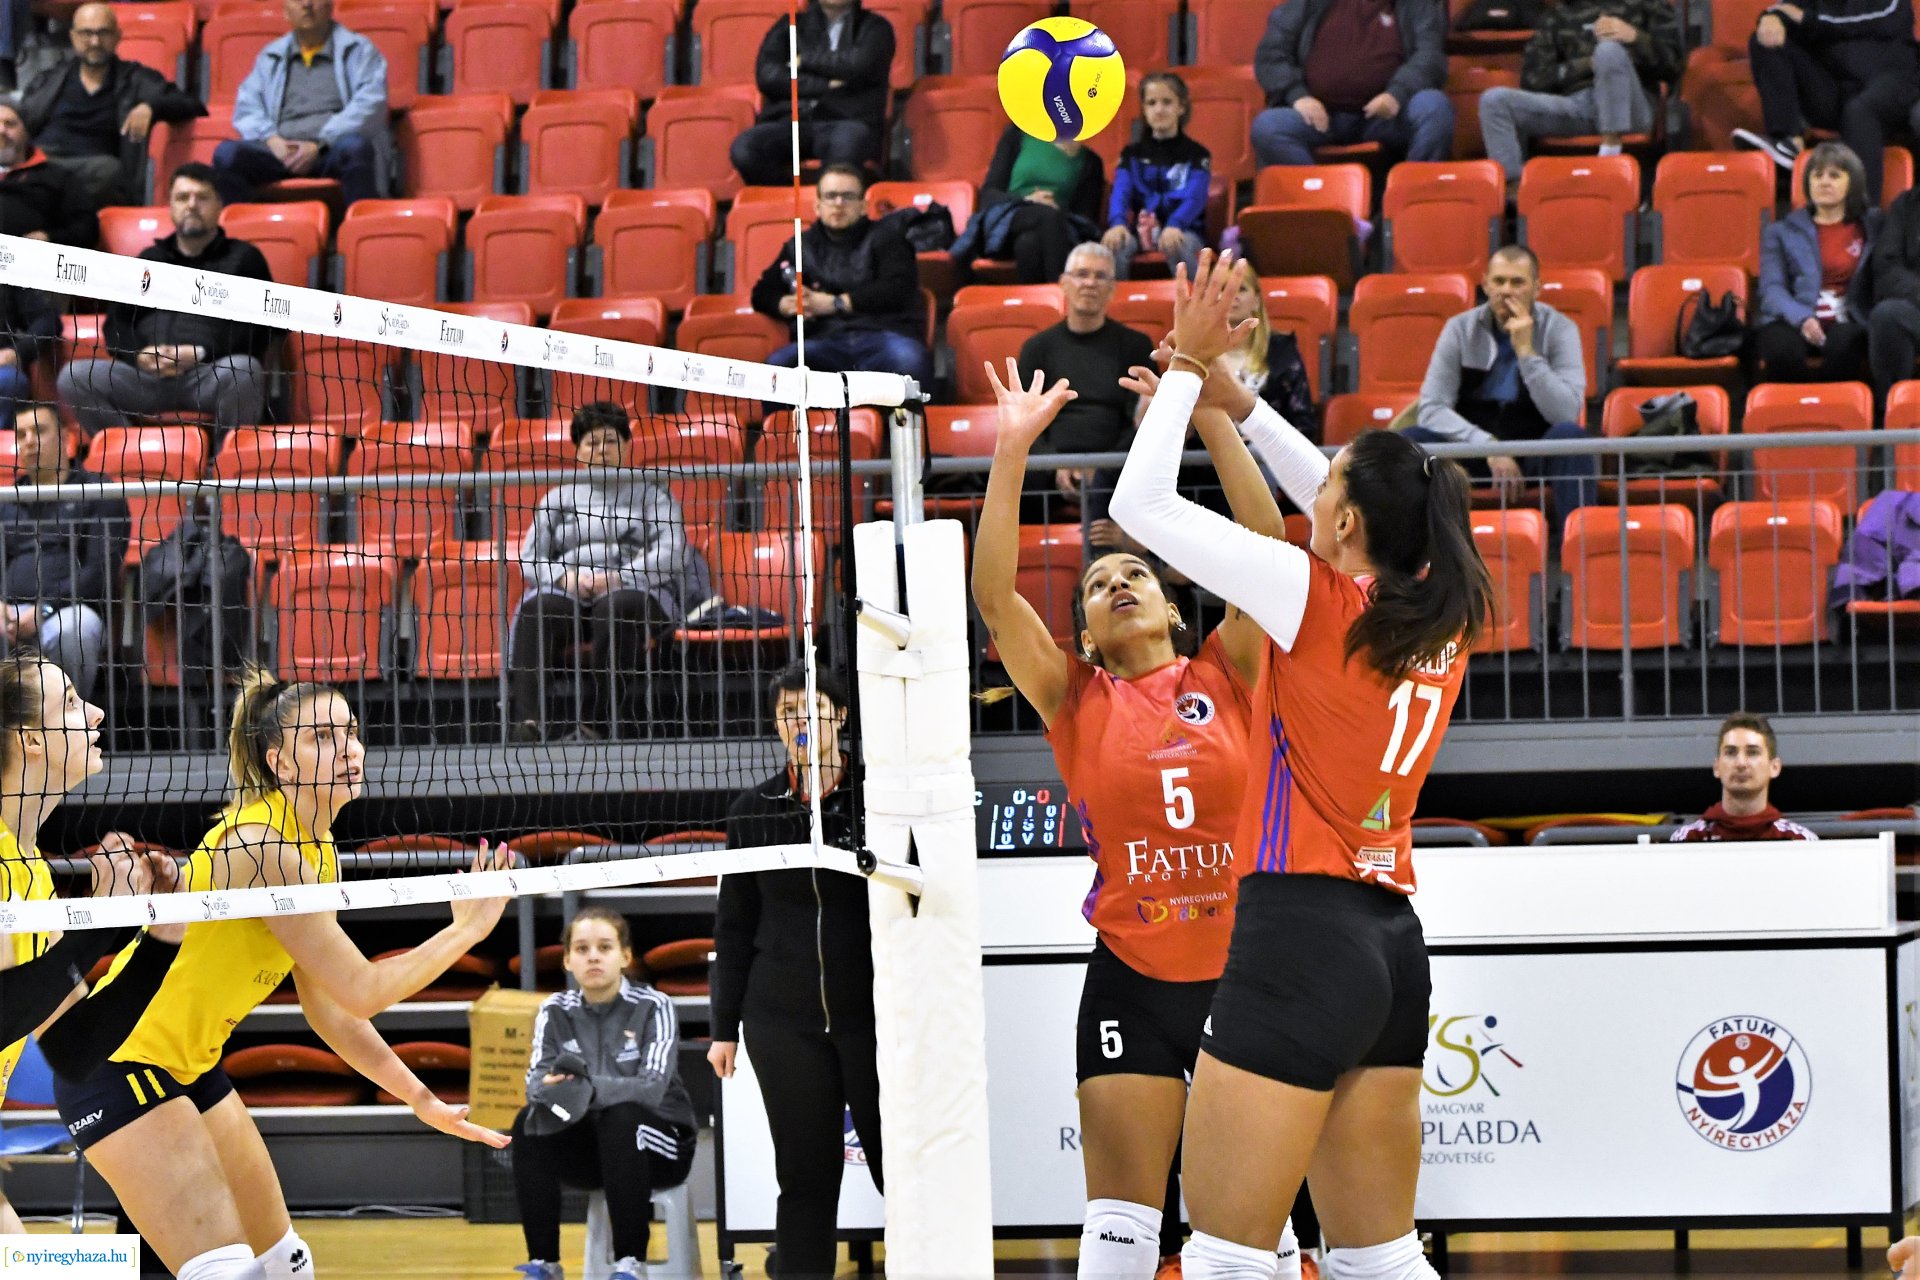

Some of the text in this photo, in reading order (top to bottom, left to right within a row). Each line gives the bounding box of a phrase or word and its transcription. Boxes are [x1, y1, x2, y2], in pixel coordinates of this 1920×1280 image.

[1053, 95, 1073, 124] V200W
[56, 253, 88, 283] FATUM
[263, 289, 291, 316] FATUM
[1379, 679, 1443, 777] 17
[1160, 767, 1196, 830] 5
[65, 905, 93, 925] FATUM
[1099, 1019, 1124, 1060] 5
[1709, 1019, 1777, 1040] FATUM
[1426, 1102, 1486, 1115] MAGYAR
[1059, 1126, 1083, 1151] R
[1099, 1231, 1136, 1245] MIKASA
